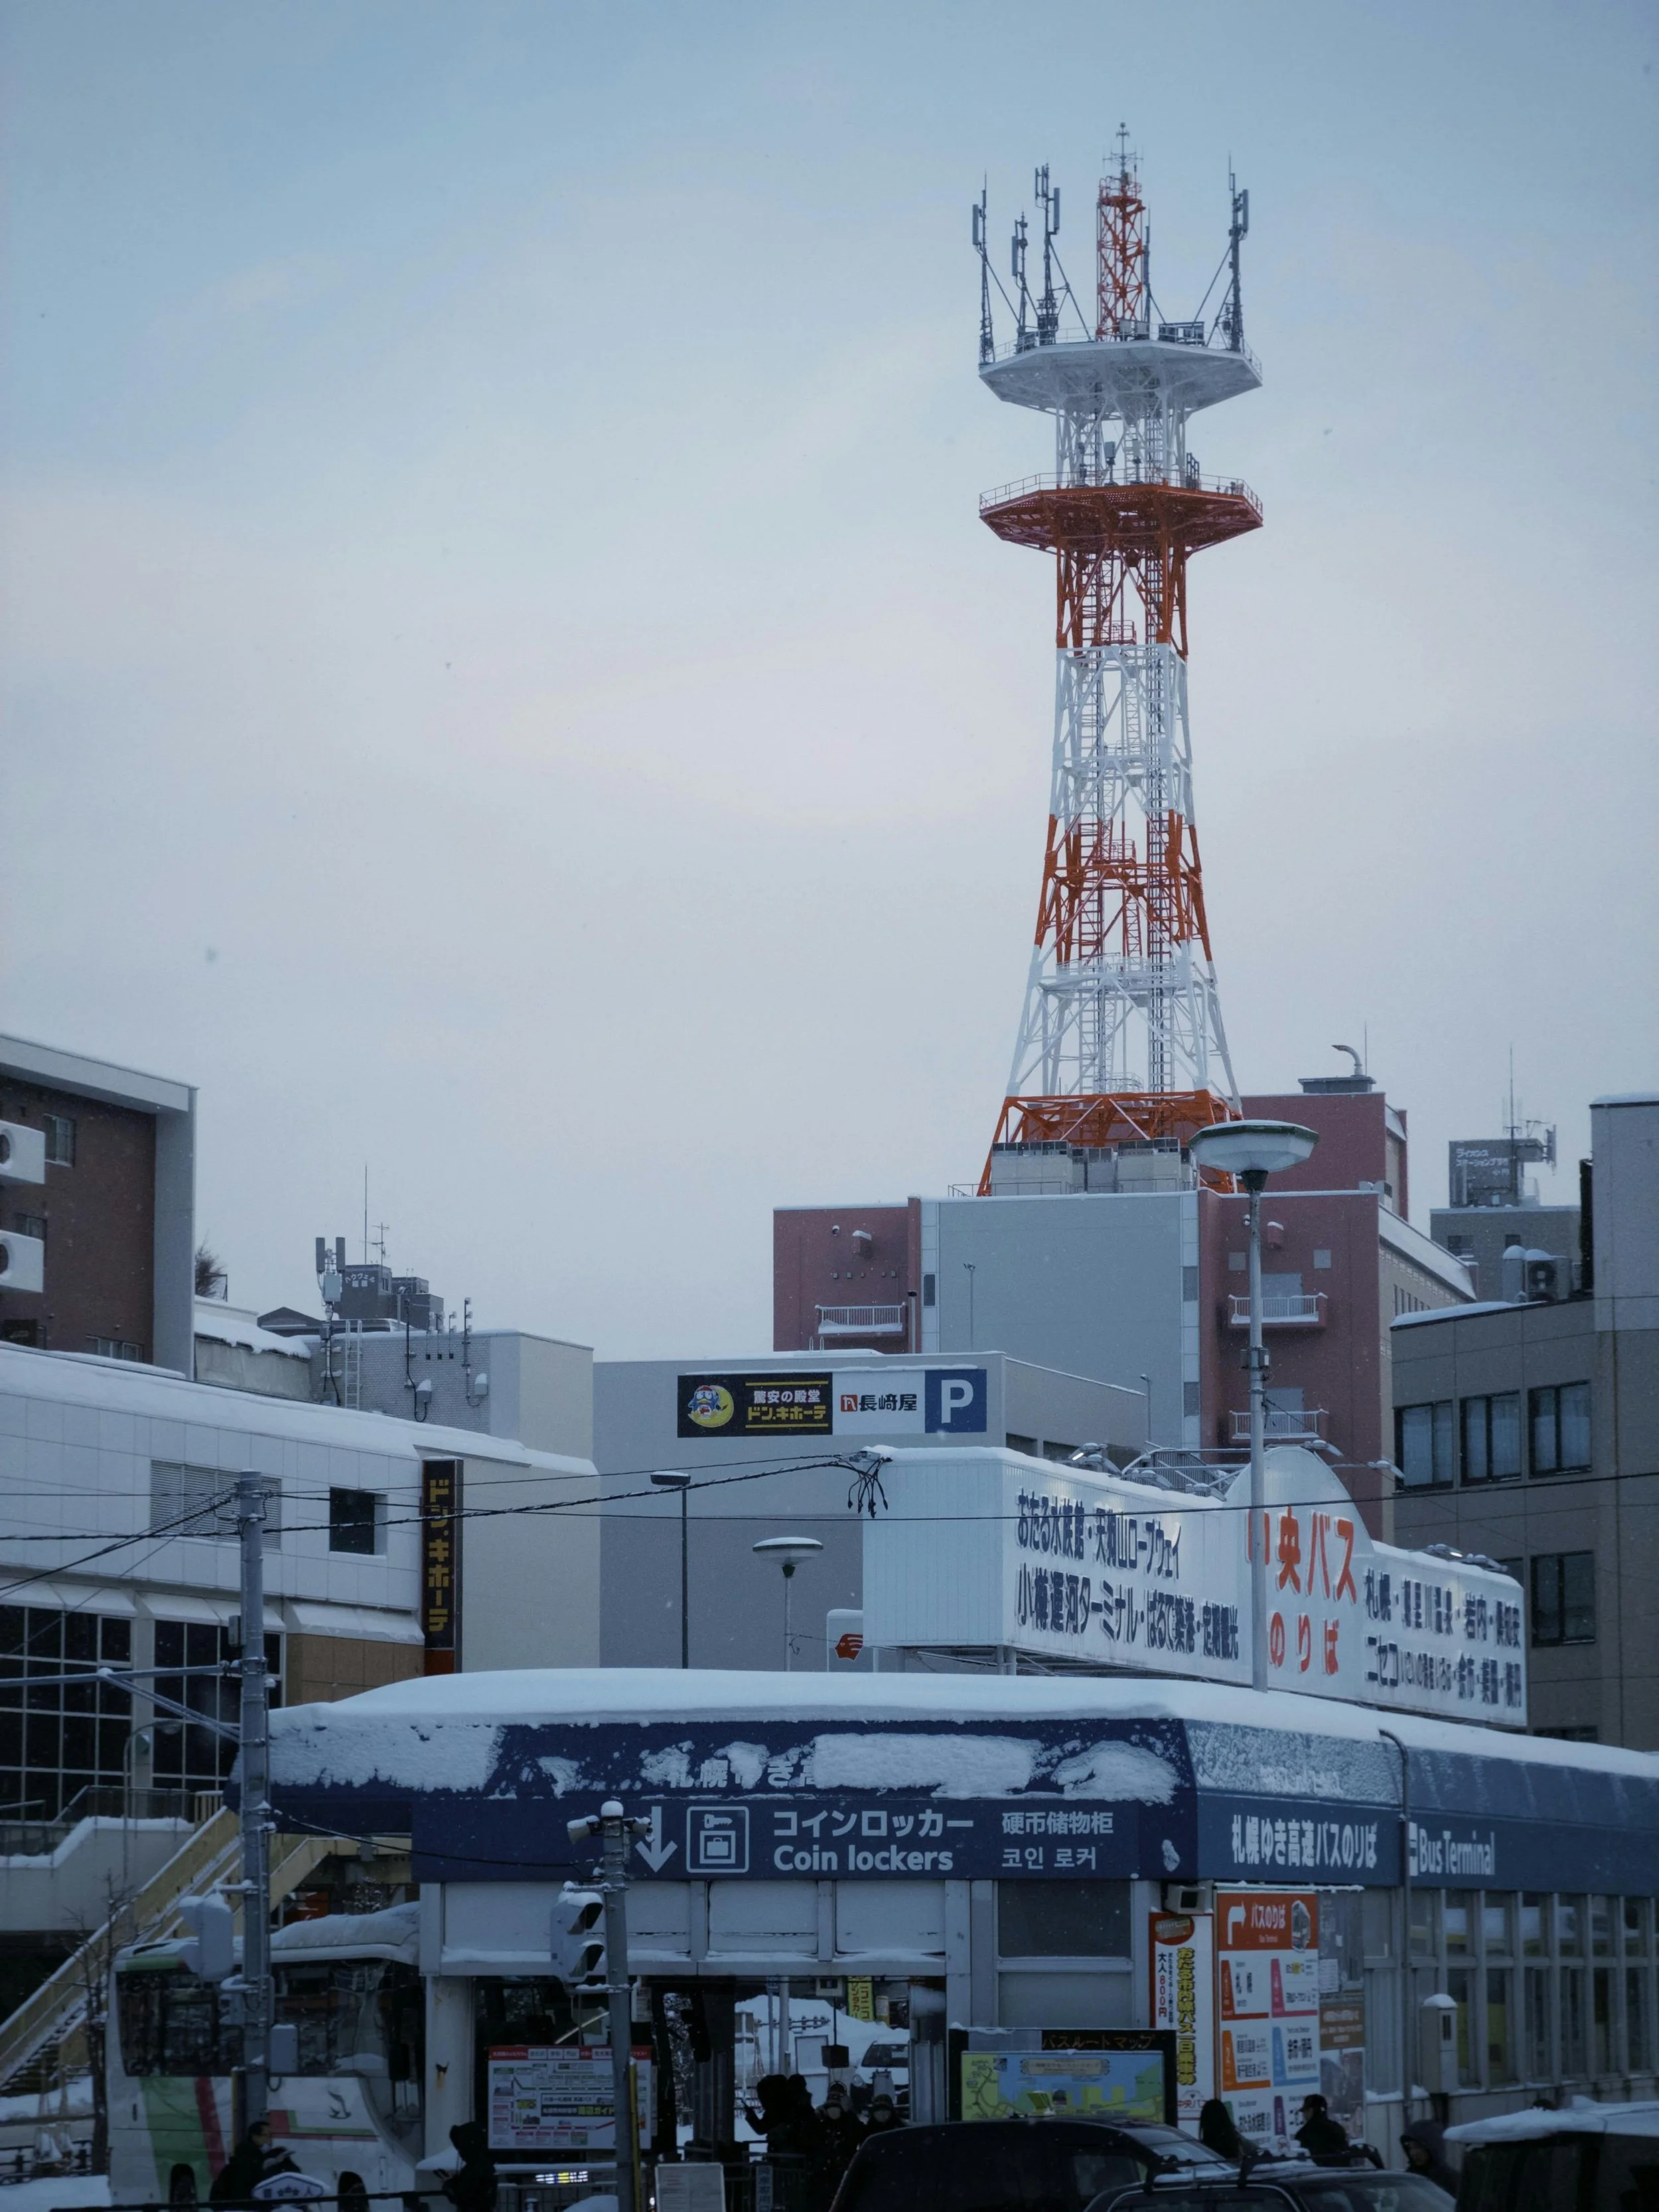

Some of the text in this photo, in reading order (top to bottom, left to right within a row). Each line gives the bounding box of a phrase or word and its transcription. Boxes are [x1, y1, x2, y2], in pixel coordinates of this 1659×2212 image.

[754, 1389, 820, 1404] 驚安の殿堂
[941, 1379, 974, 1424] P
[1270, 1612, 1339, 1676] のりば
[773, 1808, 974, 1838] コインロッカー
[1002, 1812, 1114, 1836] 硬币储物柜
[1232, 1814, 1378, 1869] 札幌ゆき高速バスのりば
[1419, 1828, 1495, 1875] Bus Terminal
[774, 1843, 954, 1871] Coin lockers
[1002, 1847, 1098, 1870] 코인 로커
[1251, 1901, 1286, 1929] バスのりば
[1158, 1953, 1167, 2018] 大人800円
[1043, 2034, 1154, 2049] バスルートマップ
